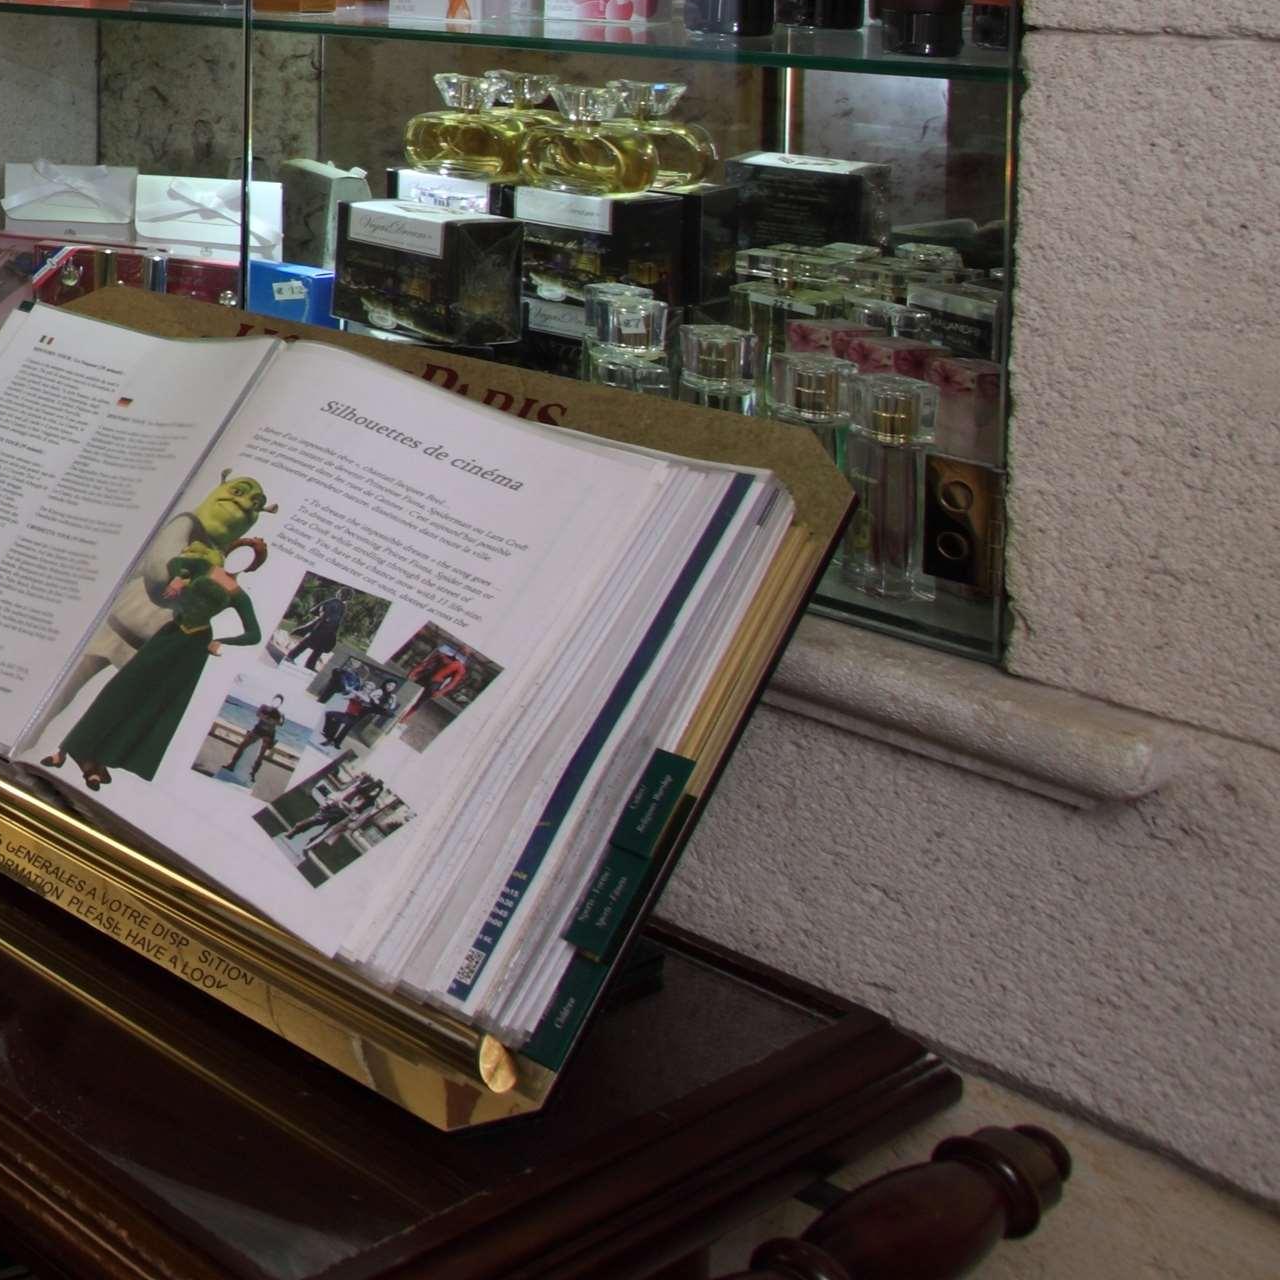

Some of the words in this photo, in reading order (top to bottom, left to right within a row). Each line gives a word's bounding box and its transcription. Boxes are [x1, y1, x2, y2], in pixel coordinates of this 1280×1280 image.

[320, 400, 420, 449] Silhouettes
[423, 445, 449, 467] de
[450, 454, 524, 492] cinéma
[67, 896, 124, 935] PLEASE
[123, 928, 166, 960] HAVE
[167, 953, 180, 968] A
[85, 884, 99, 899] A
[98, 891, 151, 929] VOTRE
[150, 922, 254, 989] DISPSITION
